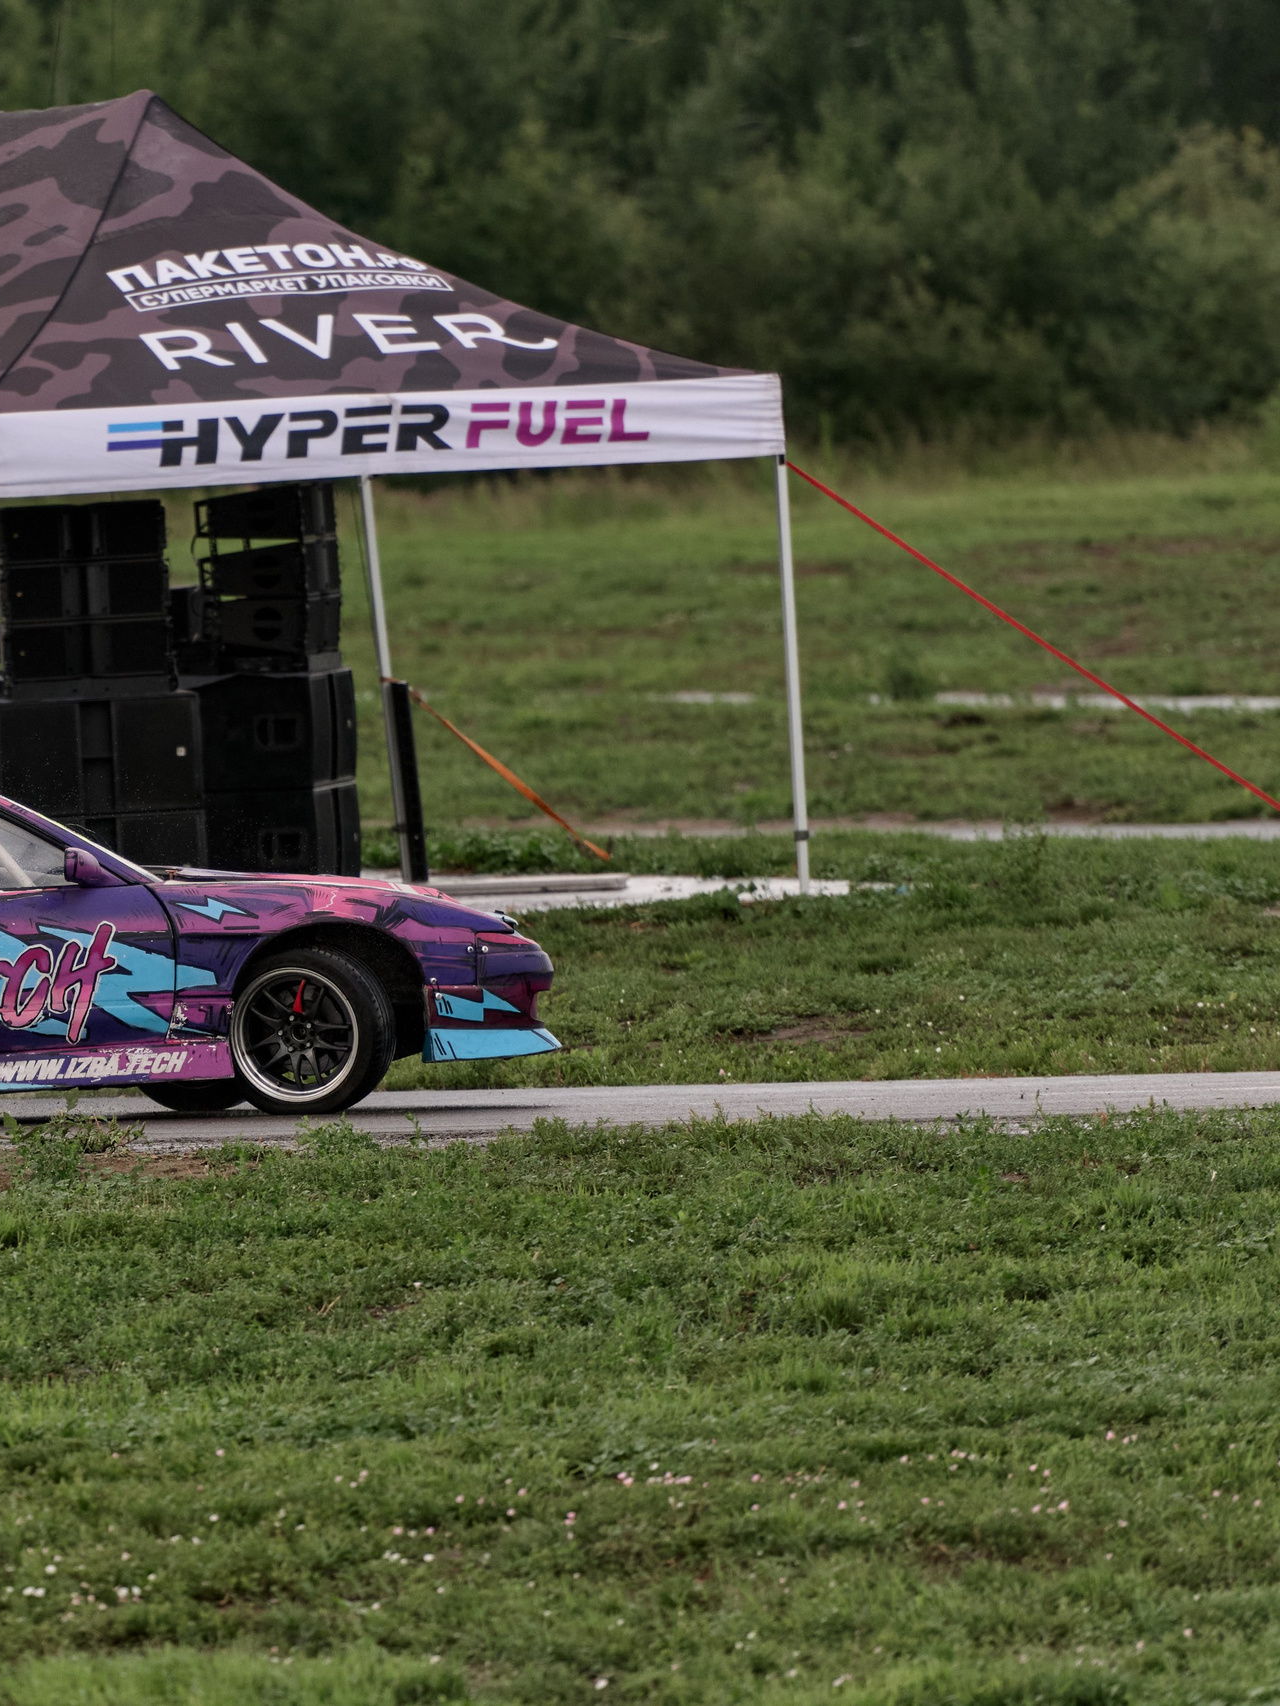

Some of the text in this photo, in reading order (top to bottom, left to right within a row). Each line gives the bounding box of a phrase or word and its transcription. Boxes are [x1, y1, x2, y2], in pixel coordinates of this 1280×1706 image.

[106, 243, 428, 293] ПАКЕТОН.РФ
[138, 273, 444, 308] СУПЕРМАРКЕТ УПАКОВКИ
[140, 312, 558, 371] RIVER
